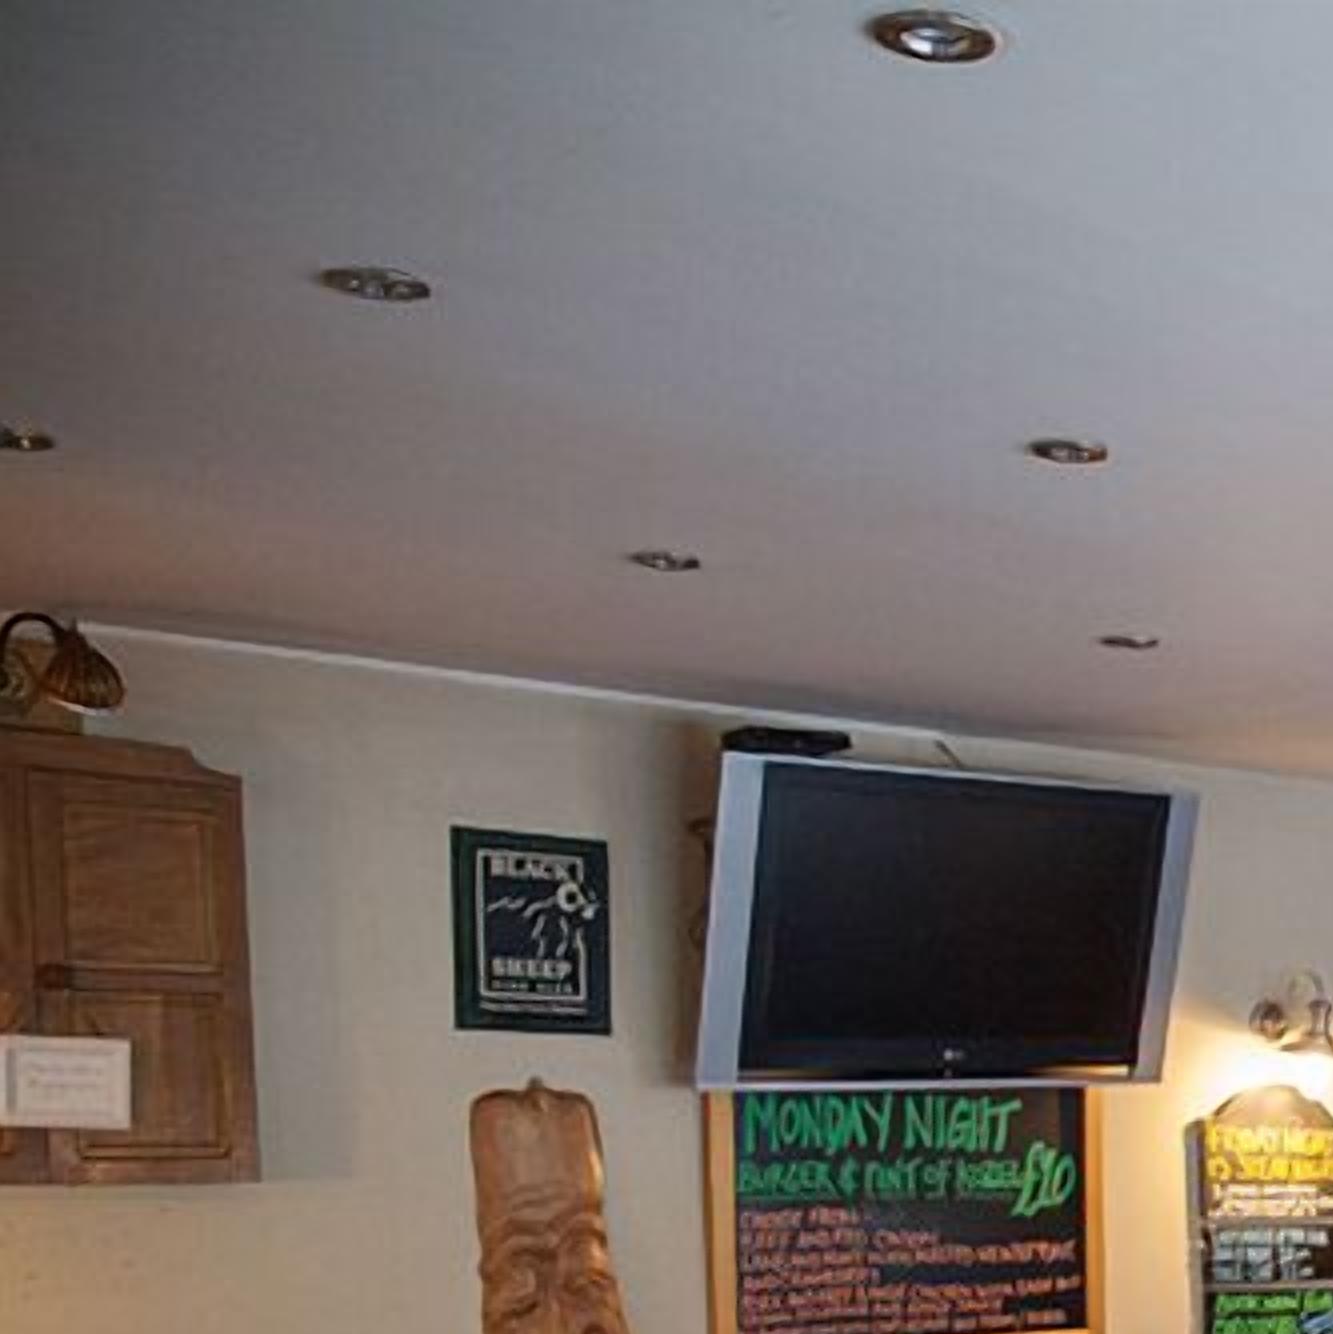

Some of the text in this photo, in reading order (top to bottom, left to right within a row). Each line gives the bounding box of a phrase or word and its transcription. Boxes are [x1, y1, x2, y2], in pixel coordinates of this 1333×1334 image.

[744, 1090, 1023, 1154] MONDAY NIGHT
[864, 1158, 921, 1197] PINT
[1010, 1140, 1077, 1217] £10
